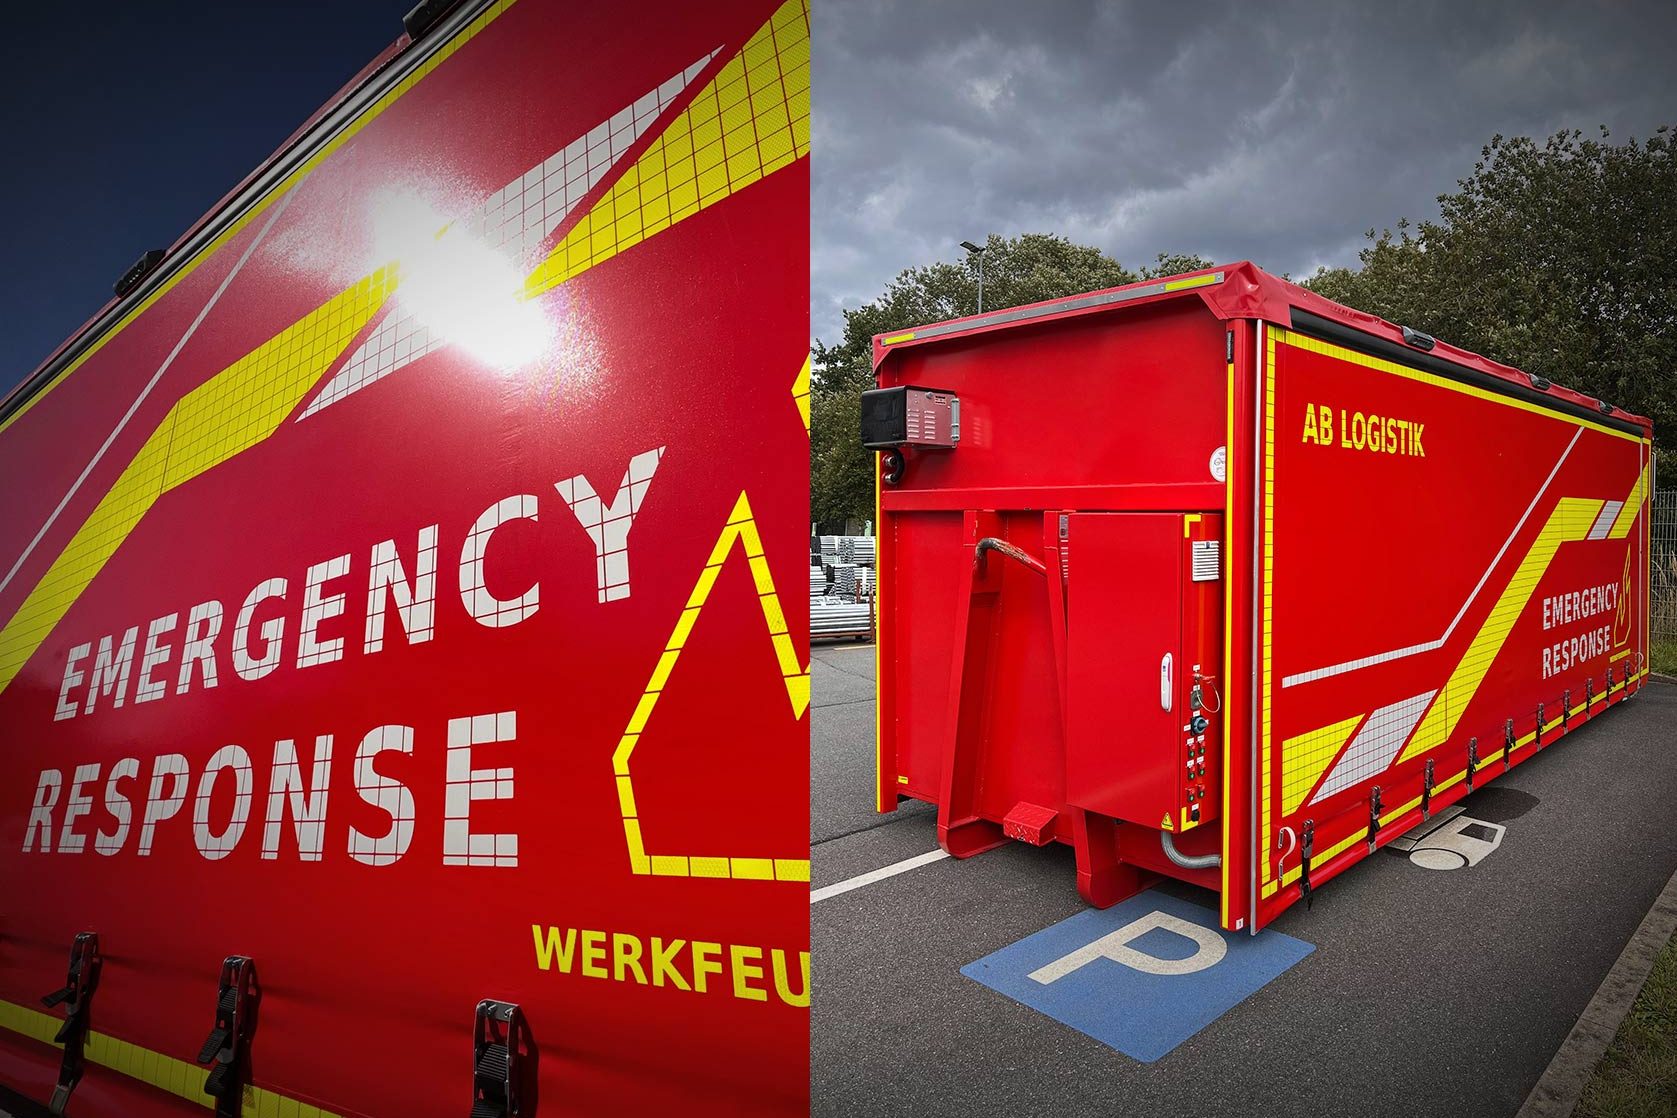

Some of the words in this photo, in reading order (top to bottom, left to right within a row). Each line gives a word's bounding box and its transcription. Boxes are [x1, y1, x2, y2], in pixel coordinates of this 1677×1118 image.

[1302, 403, 1333, 446] AB
[1341, 409, 1425, 457] LOGISTIK
[54, 446, 666, 721] EMERGENCY
[1543, 582, 1619, 630] EMERGENCY
[1542, 625, 1610, 680] RESPONSE
[22, 710, 519, 868] RESPONSE
[532, 924, 810, 1008] WERKFEU
[1027, 911, 1228, 986] P
